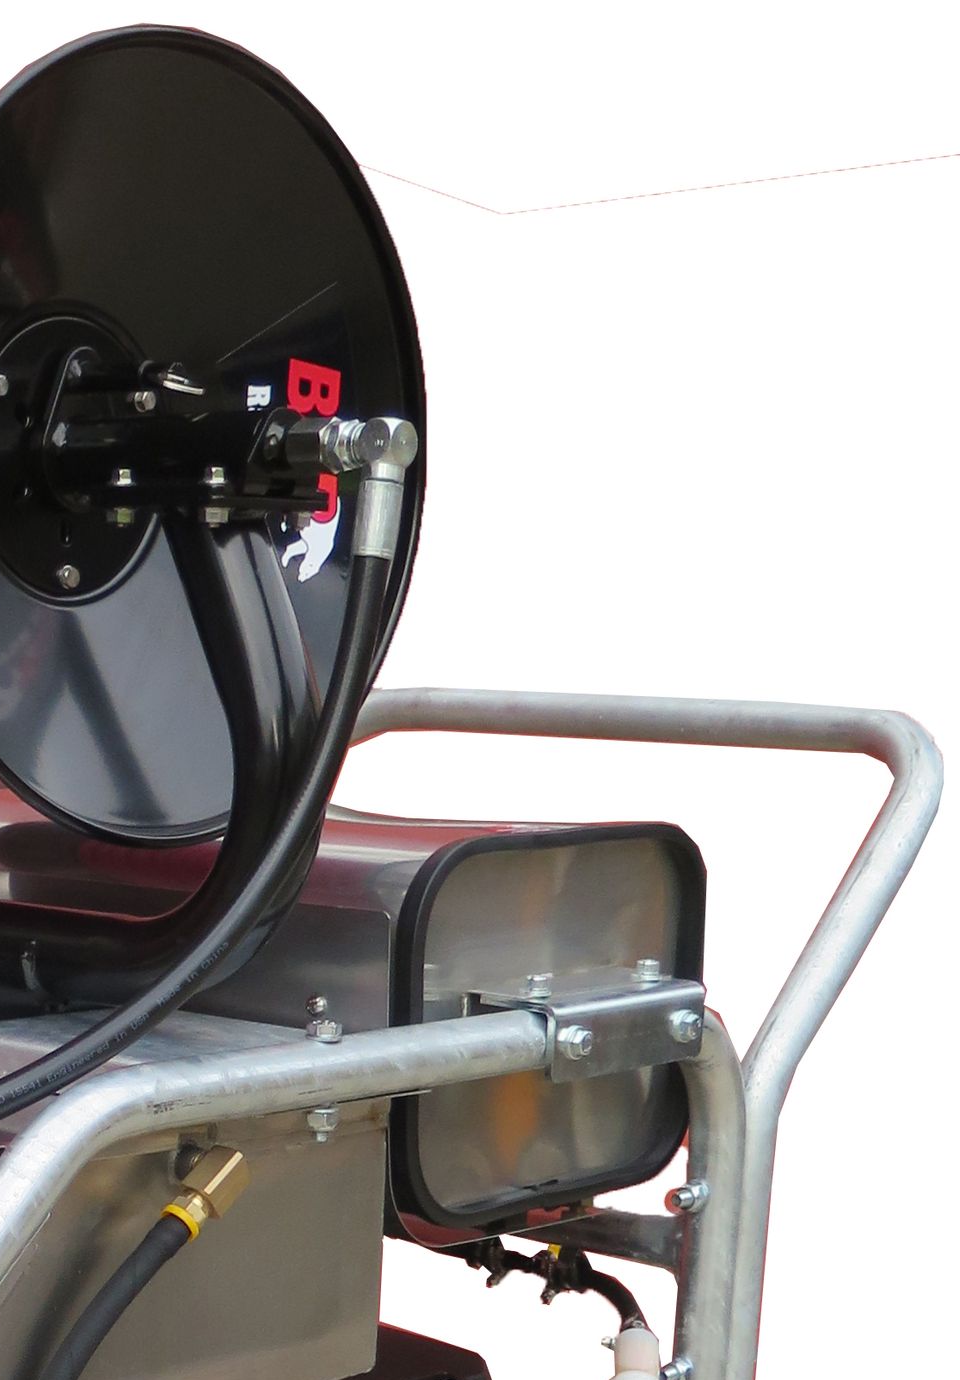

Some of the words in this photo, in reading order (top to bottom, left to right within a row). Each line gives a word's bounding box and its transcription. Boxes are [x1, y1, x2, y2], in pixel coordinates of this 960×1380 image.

[46, 1040, 111, 1083] Engineered
[114, 1030, 128, 1043] in
[130, 1011, 150, 1031] USA
[156, 983, 182, 1007] Made
[186, 970, 200, 983] in
[200, 941, 229, 970] China
